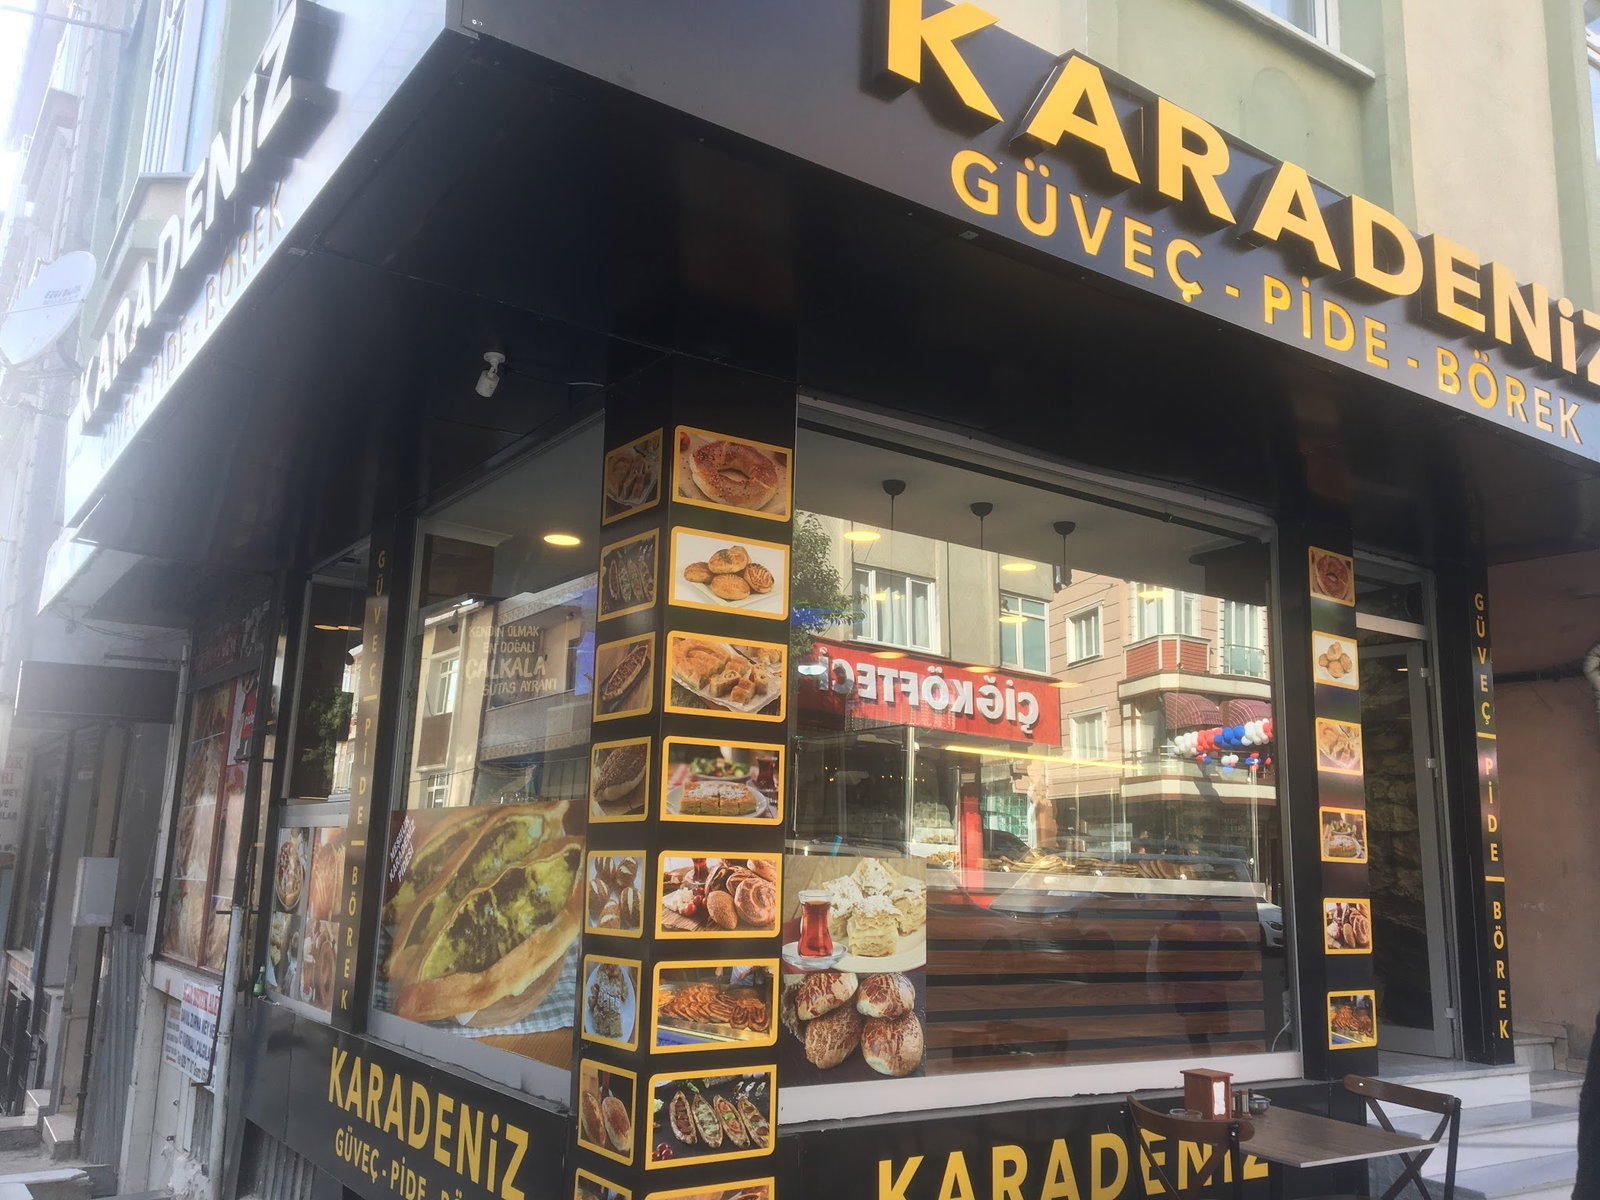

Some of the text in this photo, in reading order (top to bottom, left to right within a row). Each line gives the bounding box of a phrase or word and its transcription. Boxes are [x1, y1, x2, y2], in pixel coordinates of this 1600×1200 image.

[951, 149, 1203, 303] GÜVEÇ
[1263, 275, 1390, 370] PİDE
[1437, 345, 1583, 445] BÖREK
[508, 625, 540, 638] OLMAK
[357, 717, 371, 825] PİDE
[1474, 593, 1510, 1039] GÜVEÇ PİDE BÖREK
[340, 866, 358, 1010] BÖREK
[328, 1046, 529, 1200] KARADENİZ
[335, 1125, 380, 1184] GÜVEÇ
